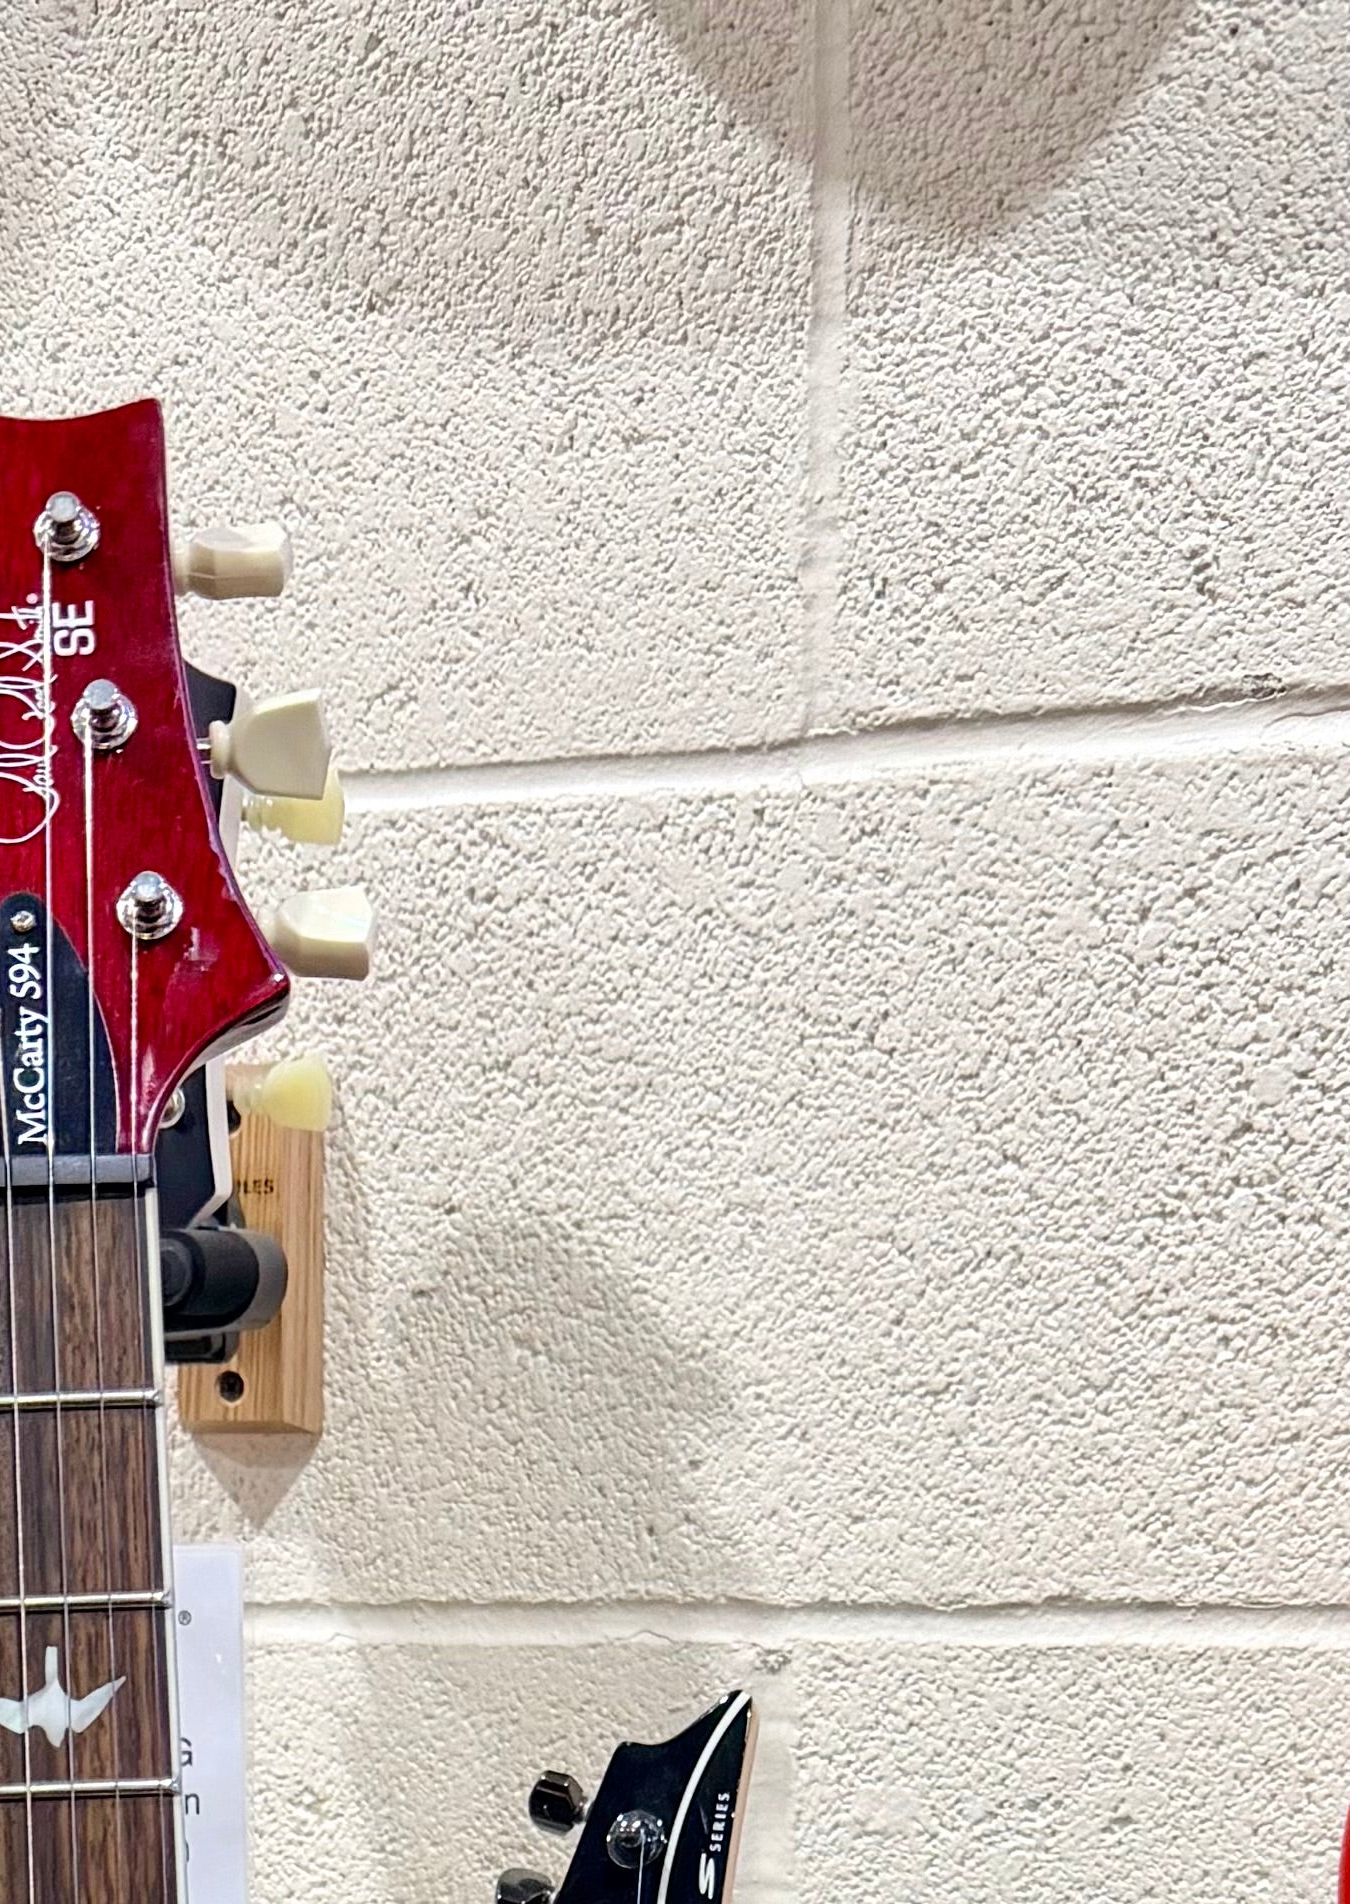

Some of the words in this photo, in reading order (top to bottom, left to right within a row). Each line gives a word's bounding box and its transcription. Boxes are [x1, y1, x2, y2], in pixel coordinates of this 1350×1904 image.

[51, 600, 95, 657] SE
[13, 1005, 50, 1146] McCarty
[709, 1792, 730, 1852] SERIES
